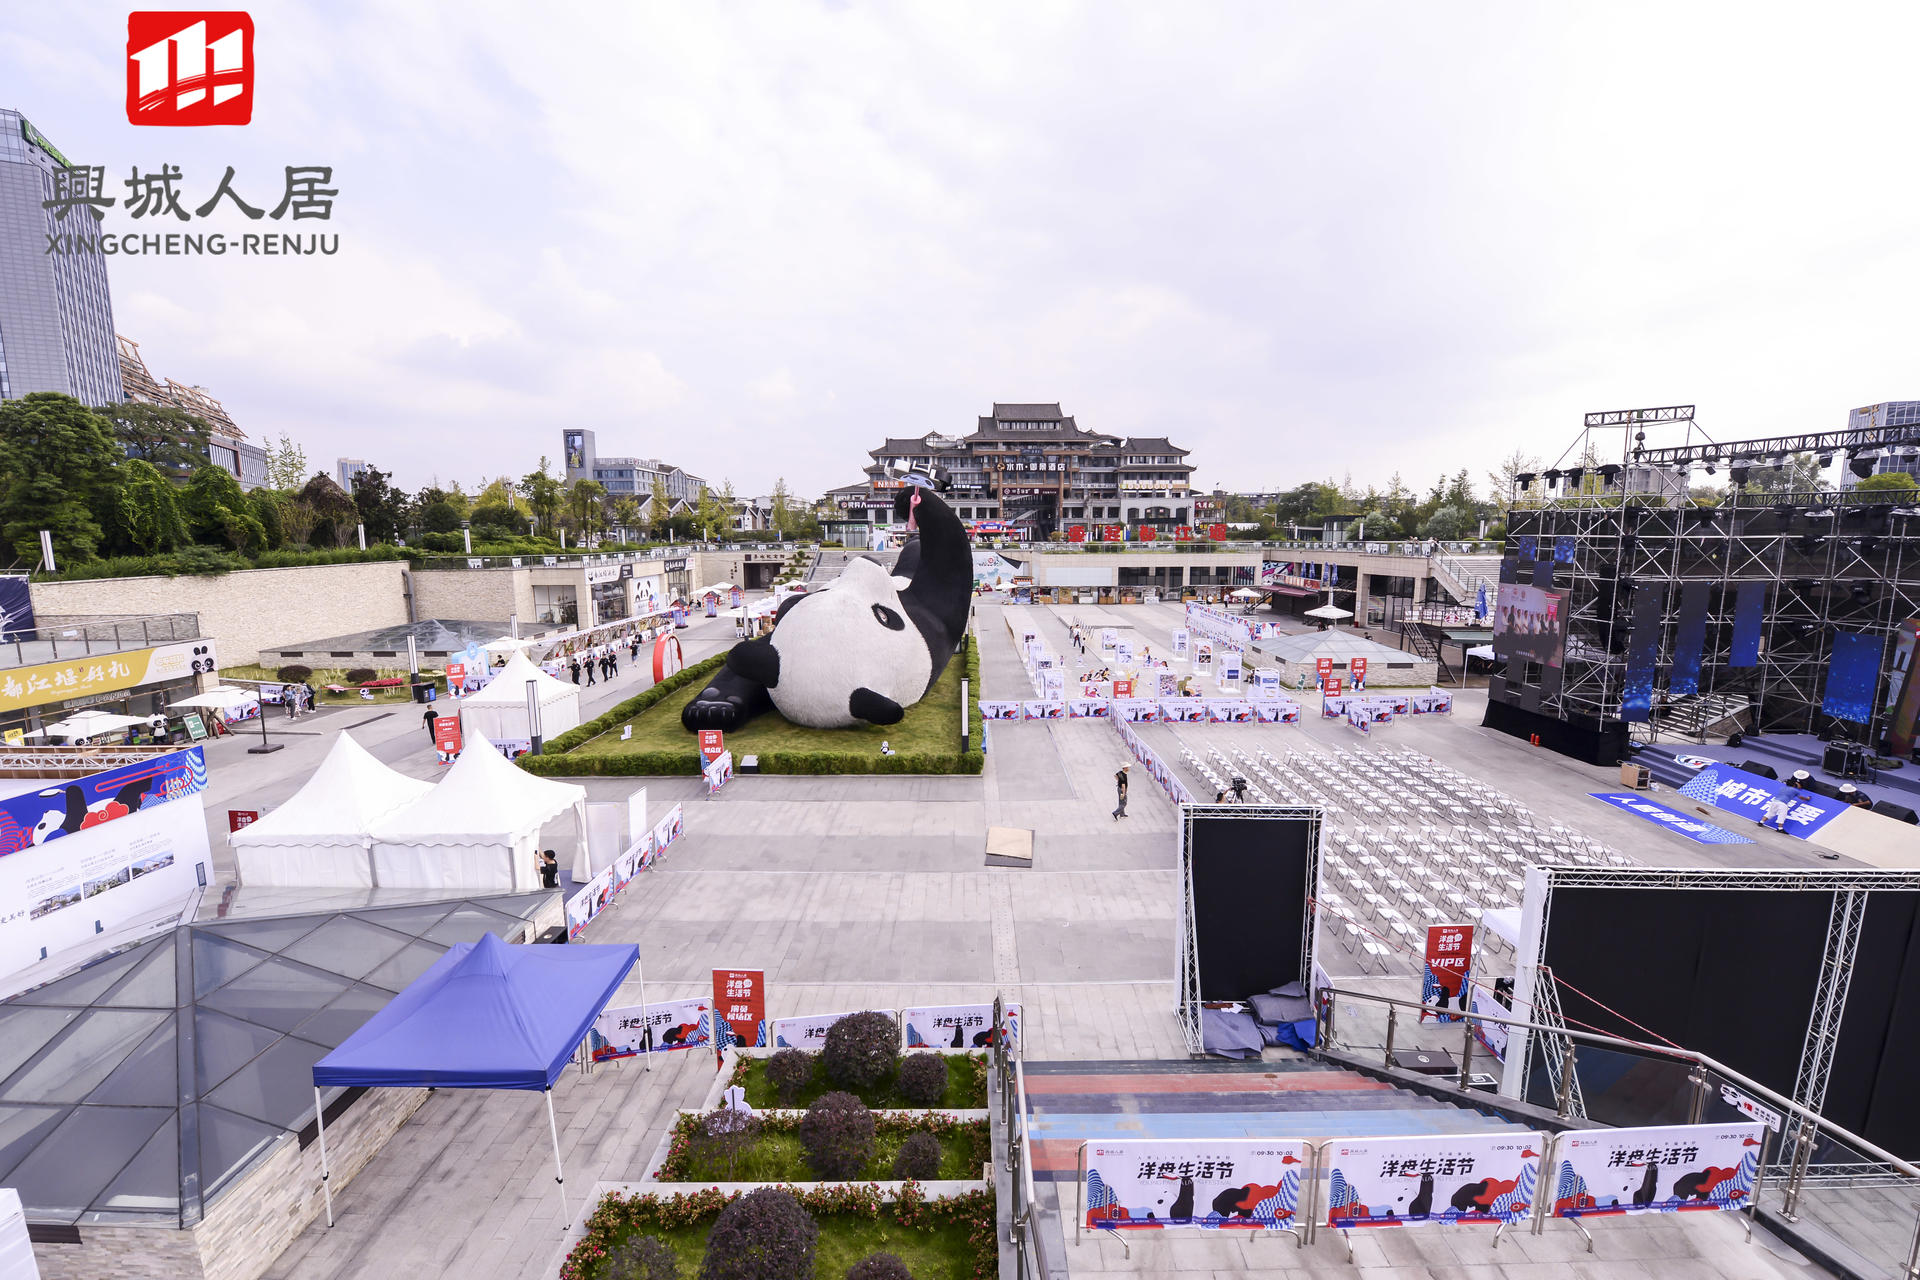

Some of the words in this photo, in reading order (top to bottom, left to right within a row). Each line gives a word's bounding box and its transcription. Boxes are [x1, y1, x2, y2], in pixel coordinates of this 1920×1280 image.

[1716, 779, 1826, 825] 城市要
[1607, 1146, 1699, 1168] 洋盘生活节
[1137, 1161, 1235, 1179] 洋盘生活节
[1379, 1158, 1475, 1178] 洋盘生活节
